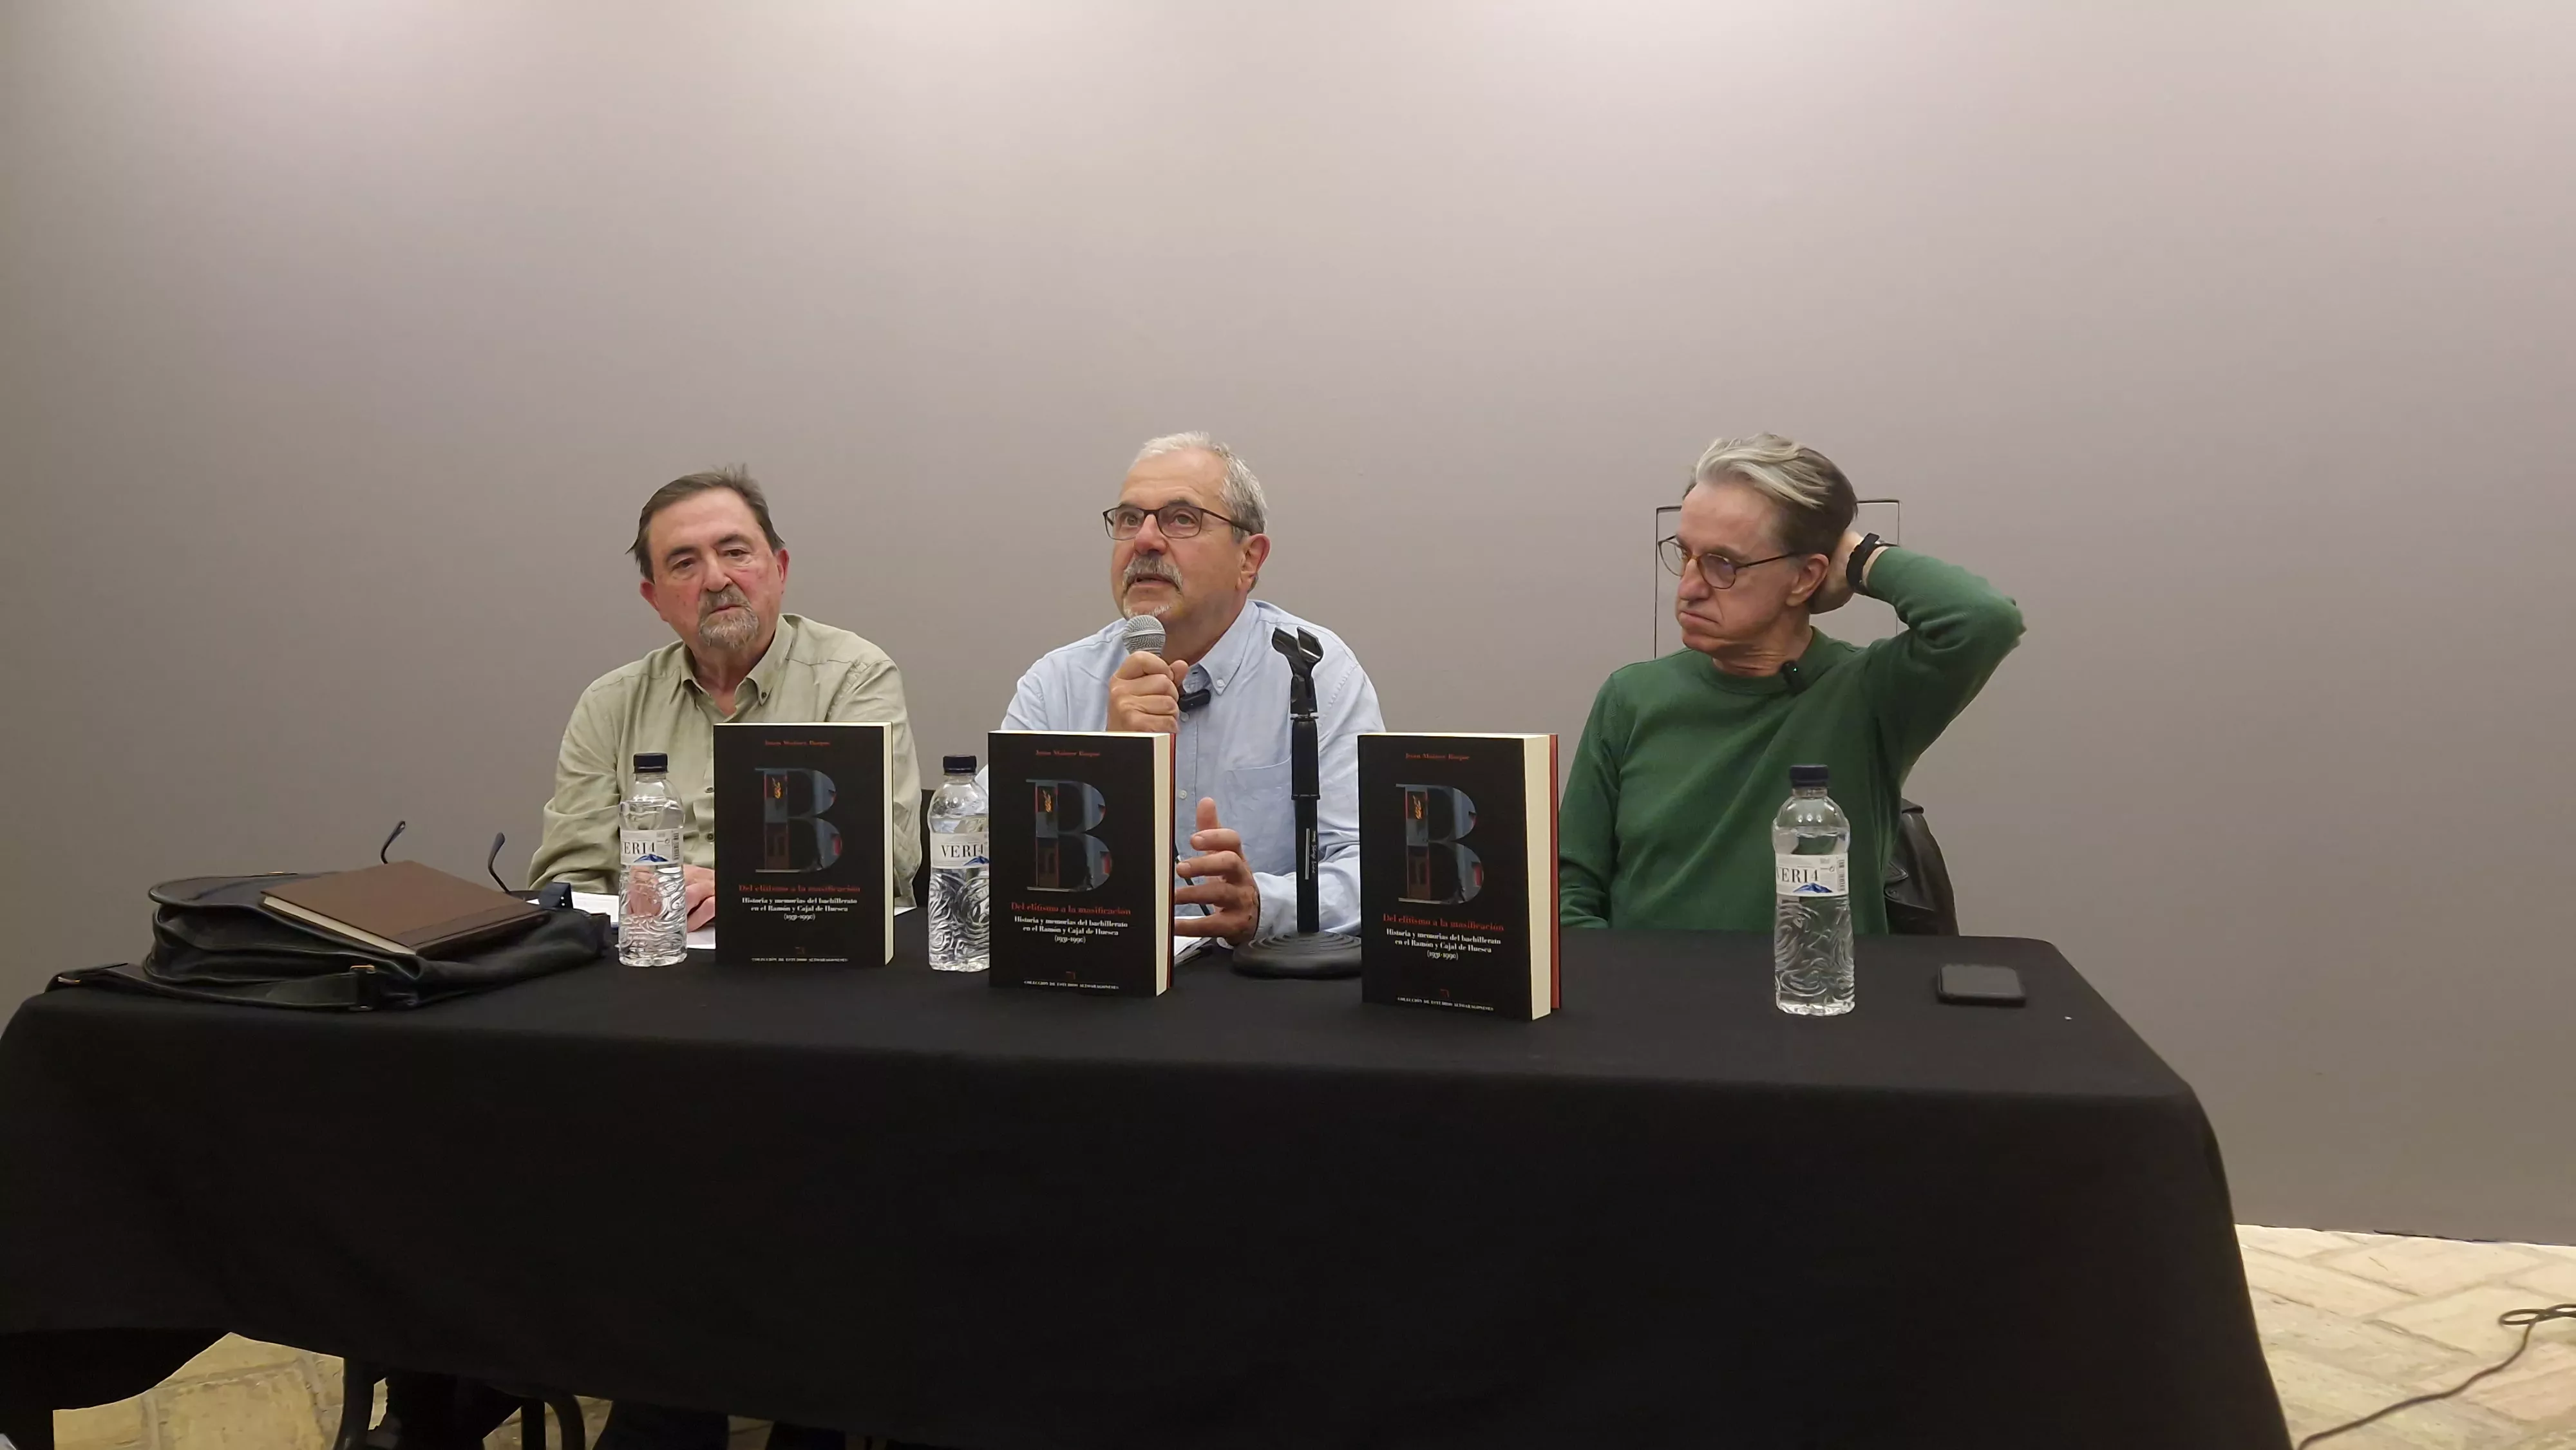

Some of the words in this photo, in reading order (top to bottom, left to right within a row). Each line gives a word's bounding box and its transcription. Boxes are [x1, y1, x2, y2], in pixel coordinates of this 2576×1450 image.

[755, 767, 842, 873] B
[1026, 779, 1112, 894] B
[622, 841, 656, 854] ERI4
[1396, 783, 1484, 905] B
[739, 884, 753, 892] Del
[1011, 902, 1025, 911] Del
[1014, 916, 1039, 924] Historia
[1383, 913, 1396, 922] Del
[1068, 927, 1084, 936] Cajal
[1095, 928, 1119, 936] Huesca
[1386, 928, 1411, 937] Historia
[1417, 932, 1448, 941] memorias
[1461, 934, 1501, 945] bachillerato
[1411, 939, 1434, 948] Ramón
[1440, 941, 1457, 951] Cajal
[1468, 944, 1492, 953] Huesca
